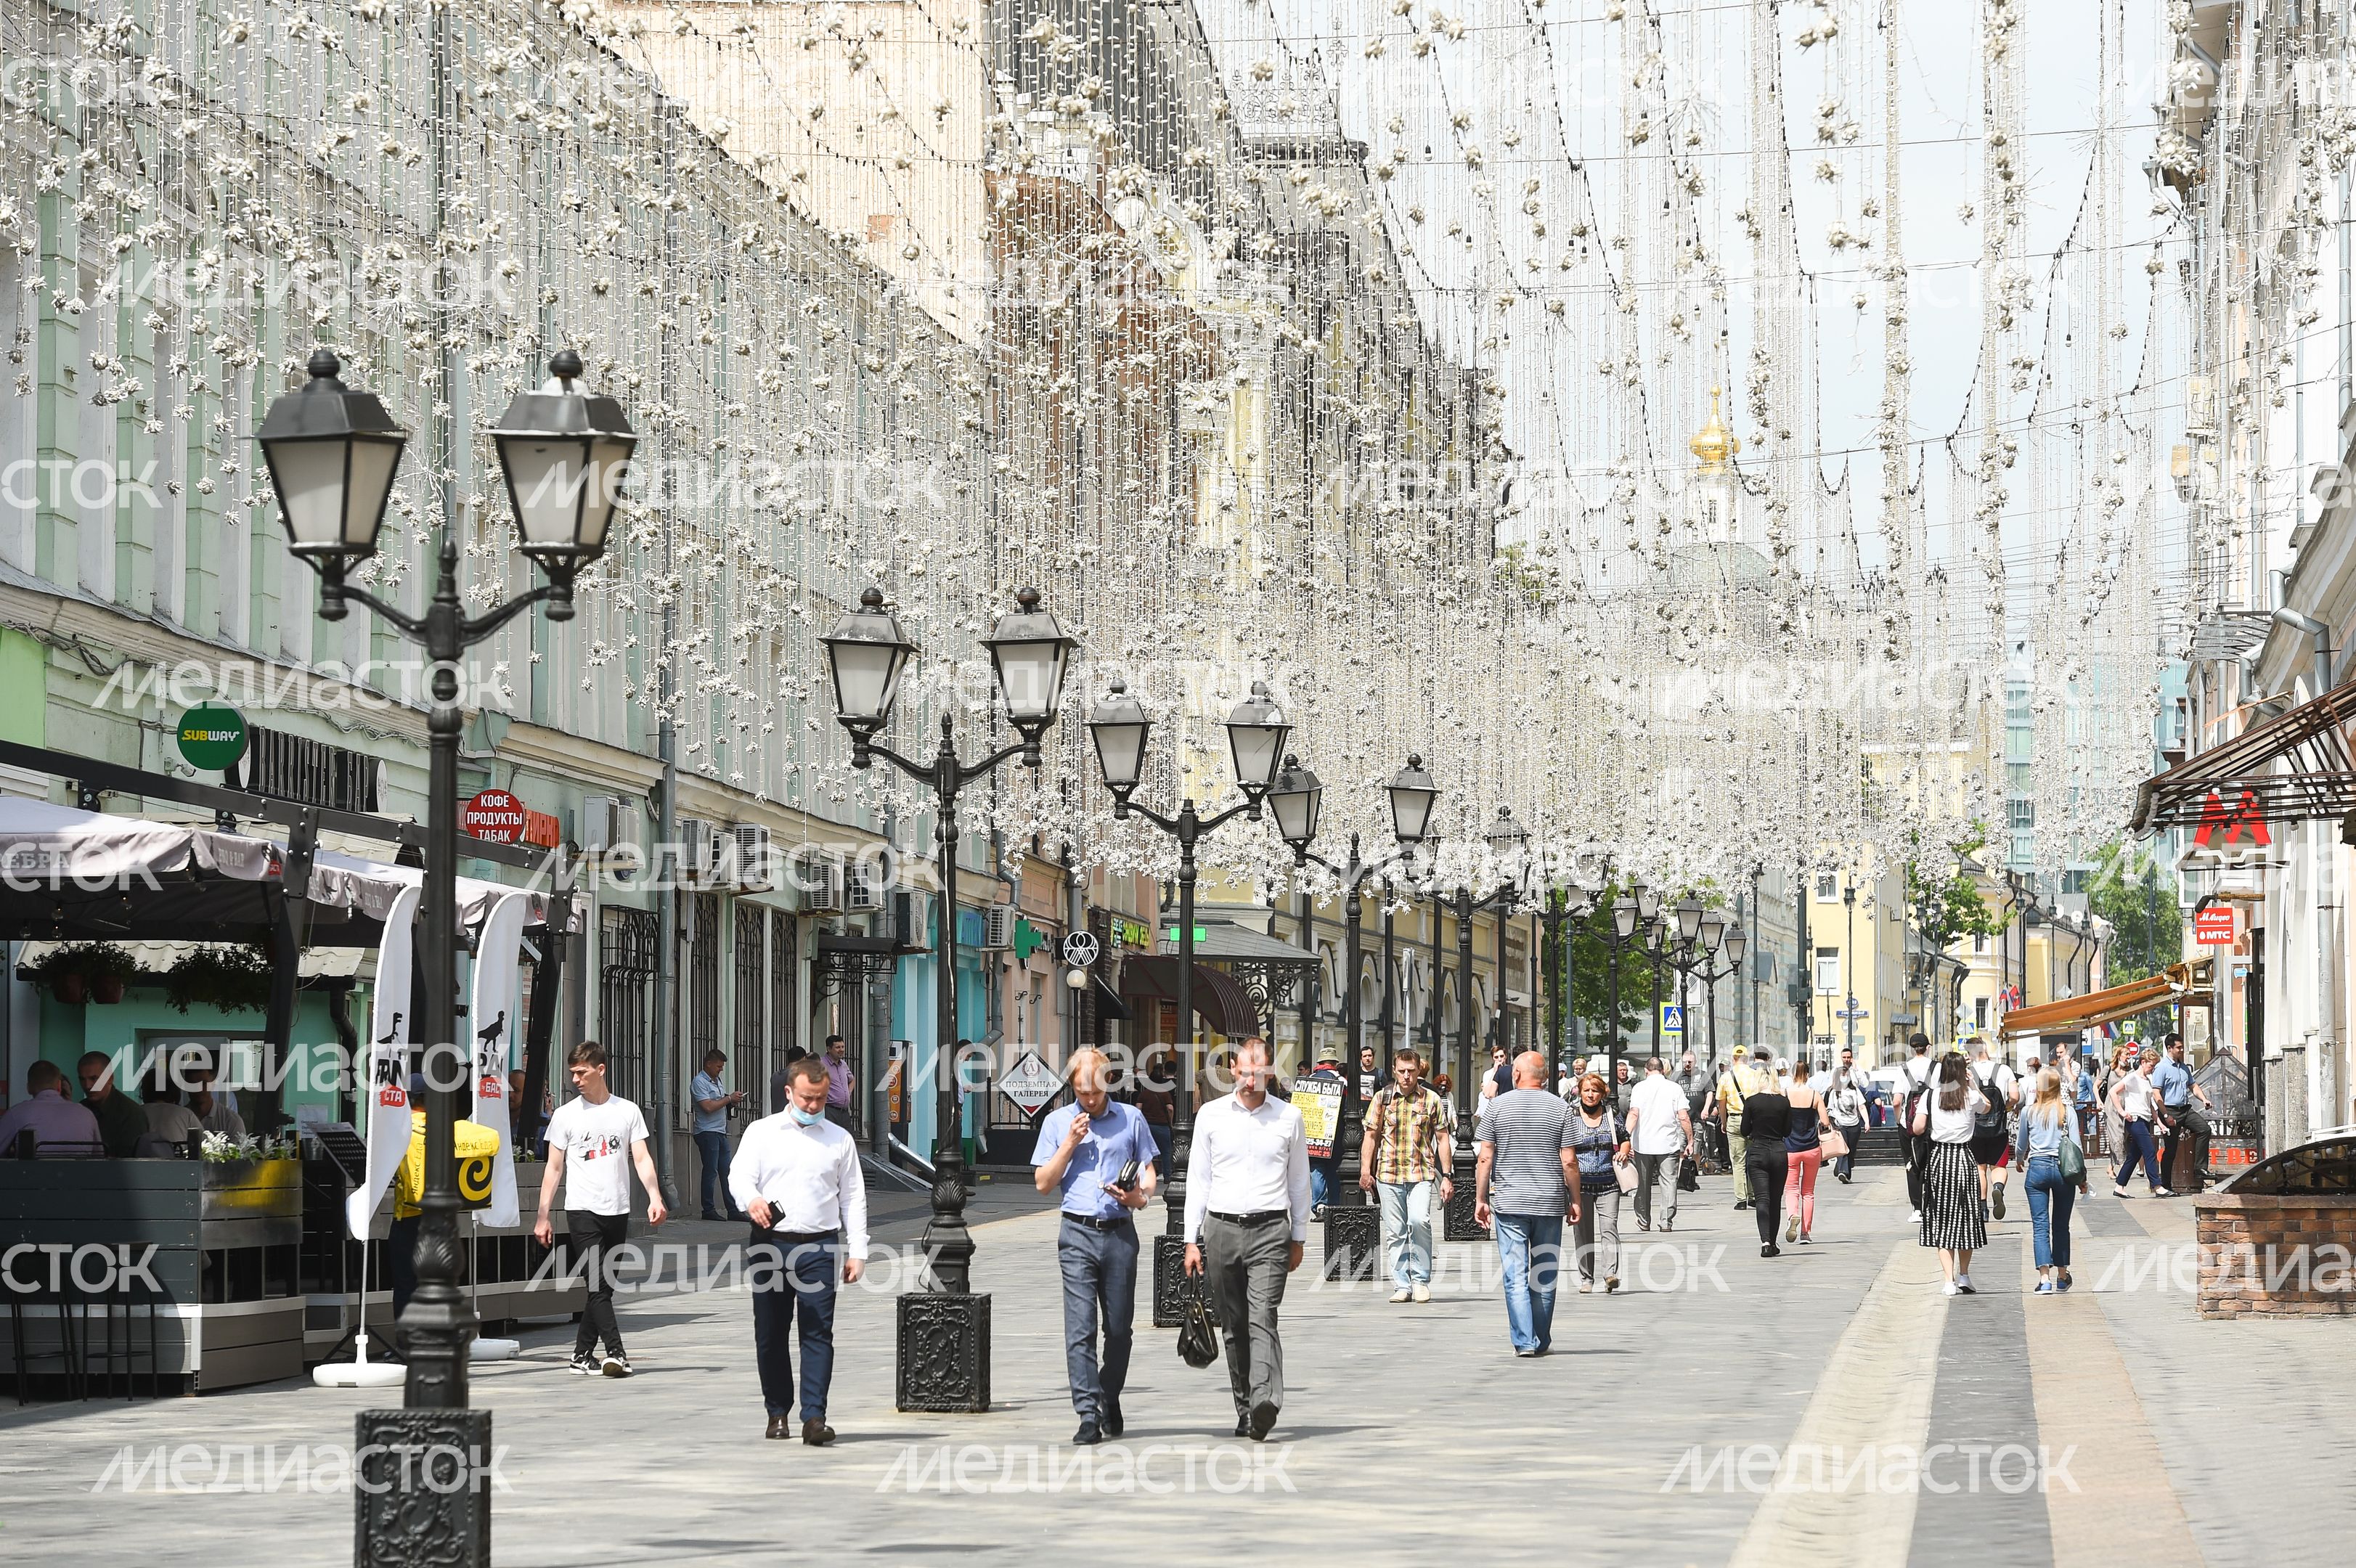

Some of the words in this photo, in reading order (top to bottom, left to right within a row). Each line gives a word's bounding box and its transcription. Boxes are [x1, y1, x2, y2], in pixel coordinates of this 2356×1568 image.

[182, 730, 240, 742] SUBWAY
[481, 794, 510, 807] КОФЕ
[467, 812, 523, 826] ПРОДУКТЫ
[478, 829, 511, 842] ТАБАК
[0, 852, 70, 869] ЕБРА
[2206, 931, 2231, 939] МТС
[1295, 1079, 1321, 1094] СЛУЖБА
[1321, 1082, 1341, 1096] БЫТА
